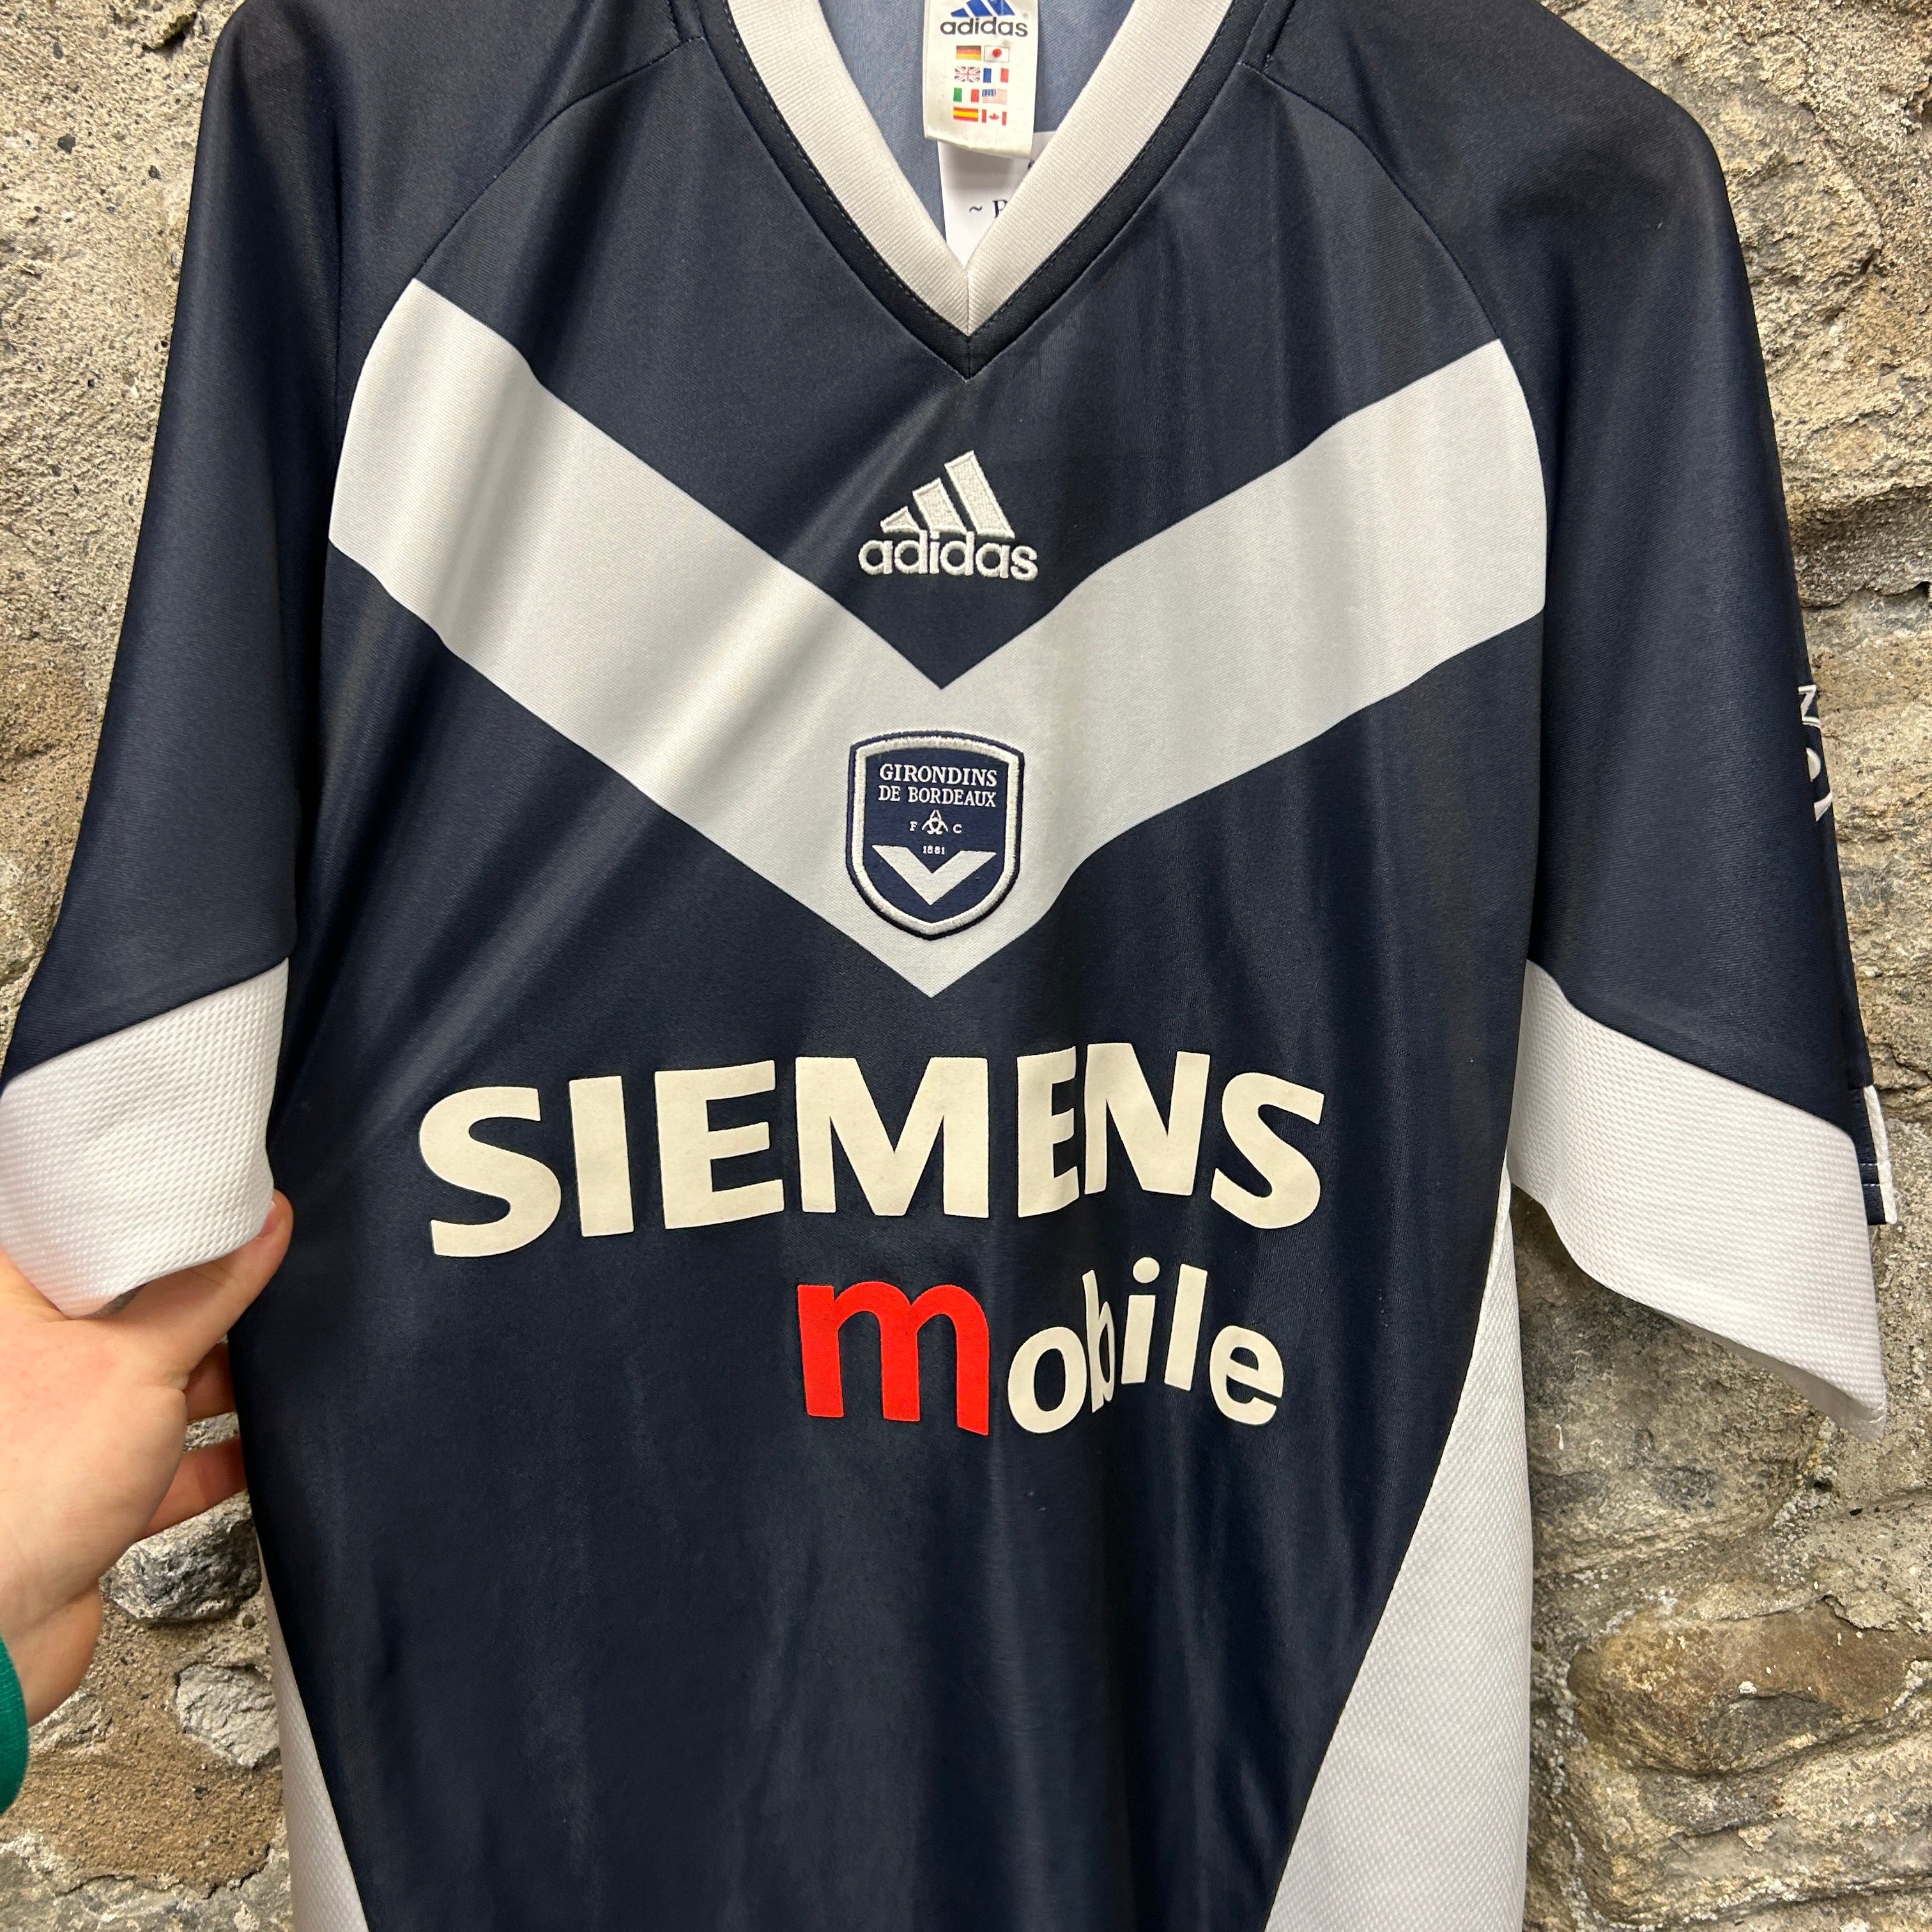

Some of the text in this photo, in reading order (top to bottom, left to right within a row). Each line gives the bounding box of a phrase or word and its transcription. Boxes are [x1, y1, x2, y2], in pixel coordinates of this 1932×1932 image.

[940, 17, 1029, 37] adidas
[858, 529, 1039, 581] adidas
[879, 763, 997, 788] GIRONDINS
[878, 785, 997, 808] DE BORDEAUX
[909, 820, 962, 834] F C
[923, 845, 946, 855] 1881
[419, 1042, 1325, 1257] SIEMENS
[797, 1257, 1285, 1436] mobile
